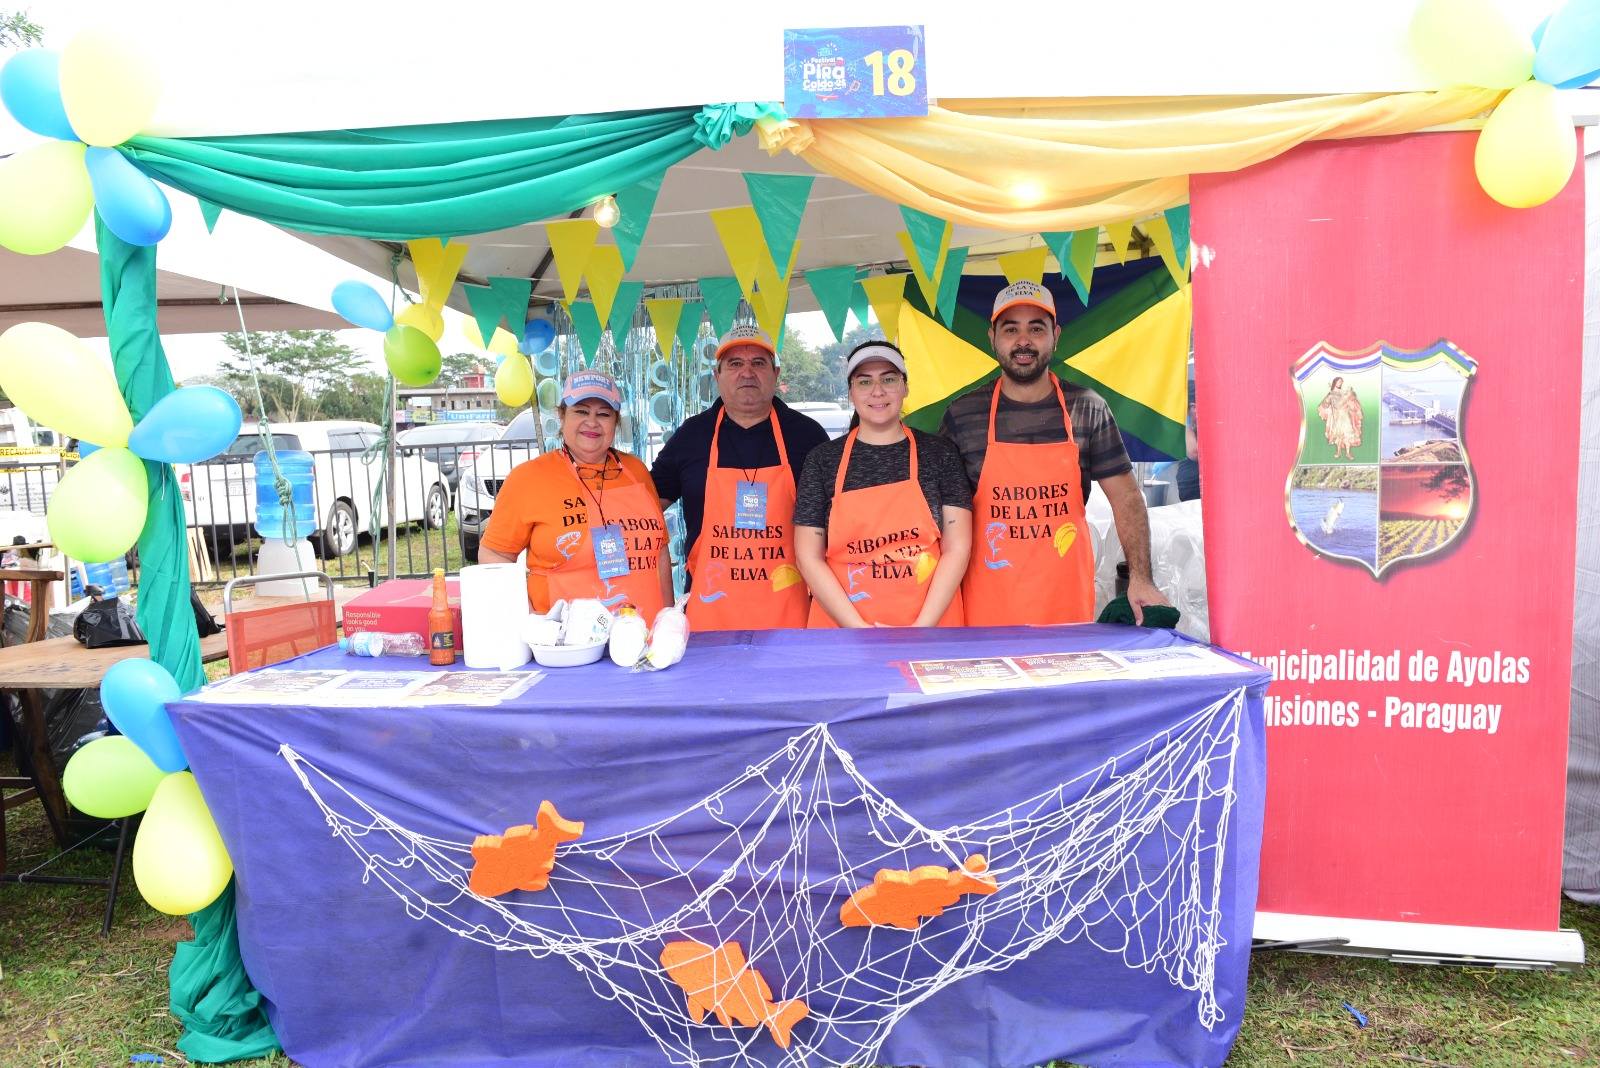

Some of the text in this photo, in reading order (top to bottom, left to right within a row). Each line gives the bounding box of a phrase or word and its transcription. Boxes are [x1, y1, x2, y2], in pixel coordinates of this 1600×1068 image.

[864, 49, 916, 96] 18
[992, 482, 1069, 501] SABORES
[990, 501, 1069, 520] DE LA TIA
[562, 513, 587, 527] DE
[712, 525, 783, 539] SABORES
[1009, 524, 1052, 540] ELVA
[634, 537, 652, 551] LA
[846, 527, 920, 554] SABORES
[710, 545, 785, 560] DE LA TIA
[628, 556, 657, 571] ELVA
[730, 568, 768, 581] ELVA
[872, 564, 913, 579] ELVA
[345, 611, 381, 619] Responsible
[363, 618, 378, 626] good
[1408, 649, 1439, 683] de
[1446, 650, 1530, 687] Ayolas
[1384, 696, 1502, 734] Paraguay
